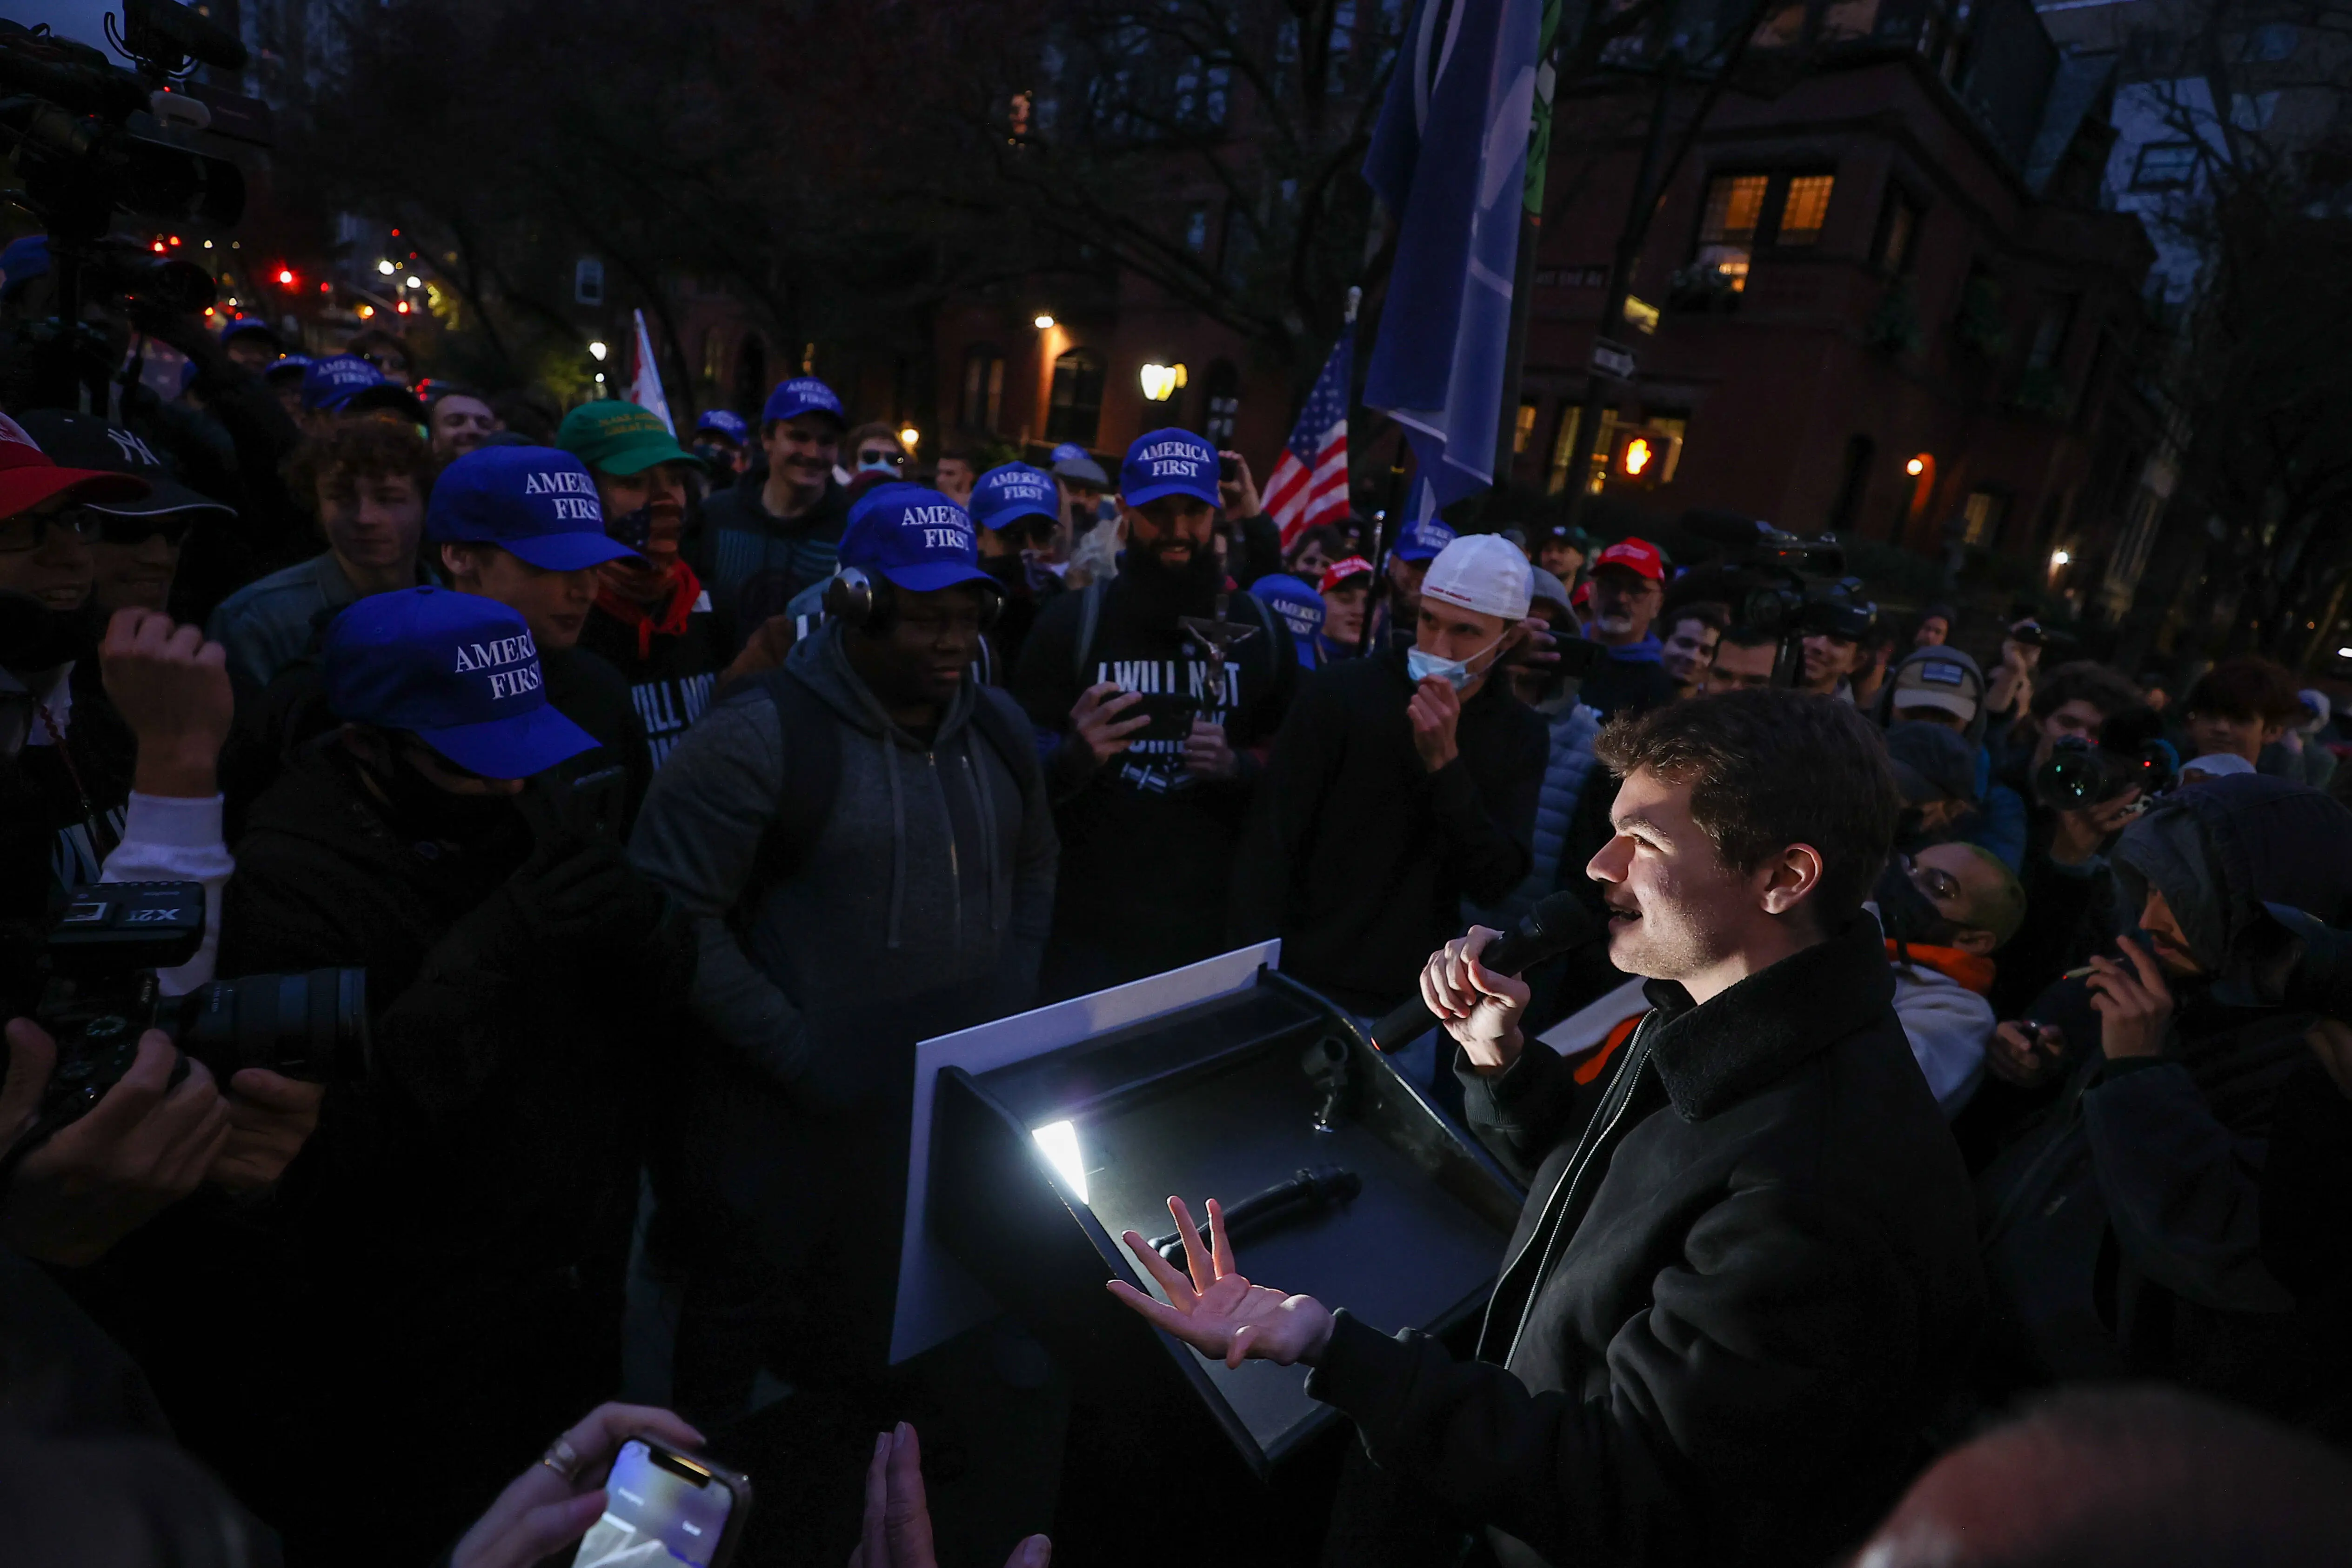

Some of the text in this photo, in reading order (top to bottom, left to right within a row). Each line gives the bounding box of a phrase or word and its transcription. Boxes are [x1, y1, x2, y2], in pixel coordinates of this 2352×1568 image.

[1137, 441, 1210, 462] AMERICA
[1151, 460, 1199, 477] FIRST
[989, 471, 1052, 491] AMERICA
[1003, 485, 1043, 501] FIRST
[551, 497, 603, 522] FIRS
